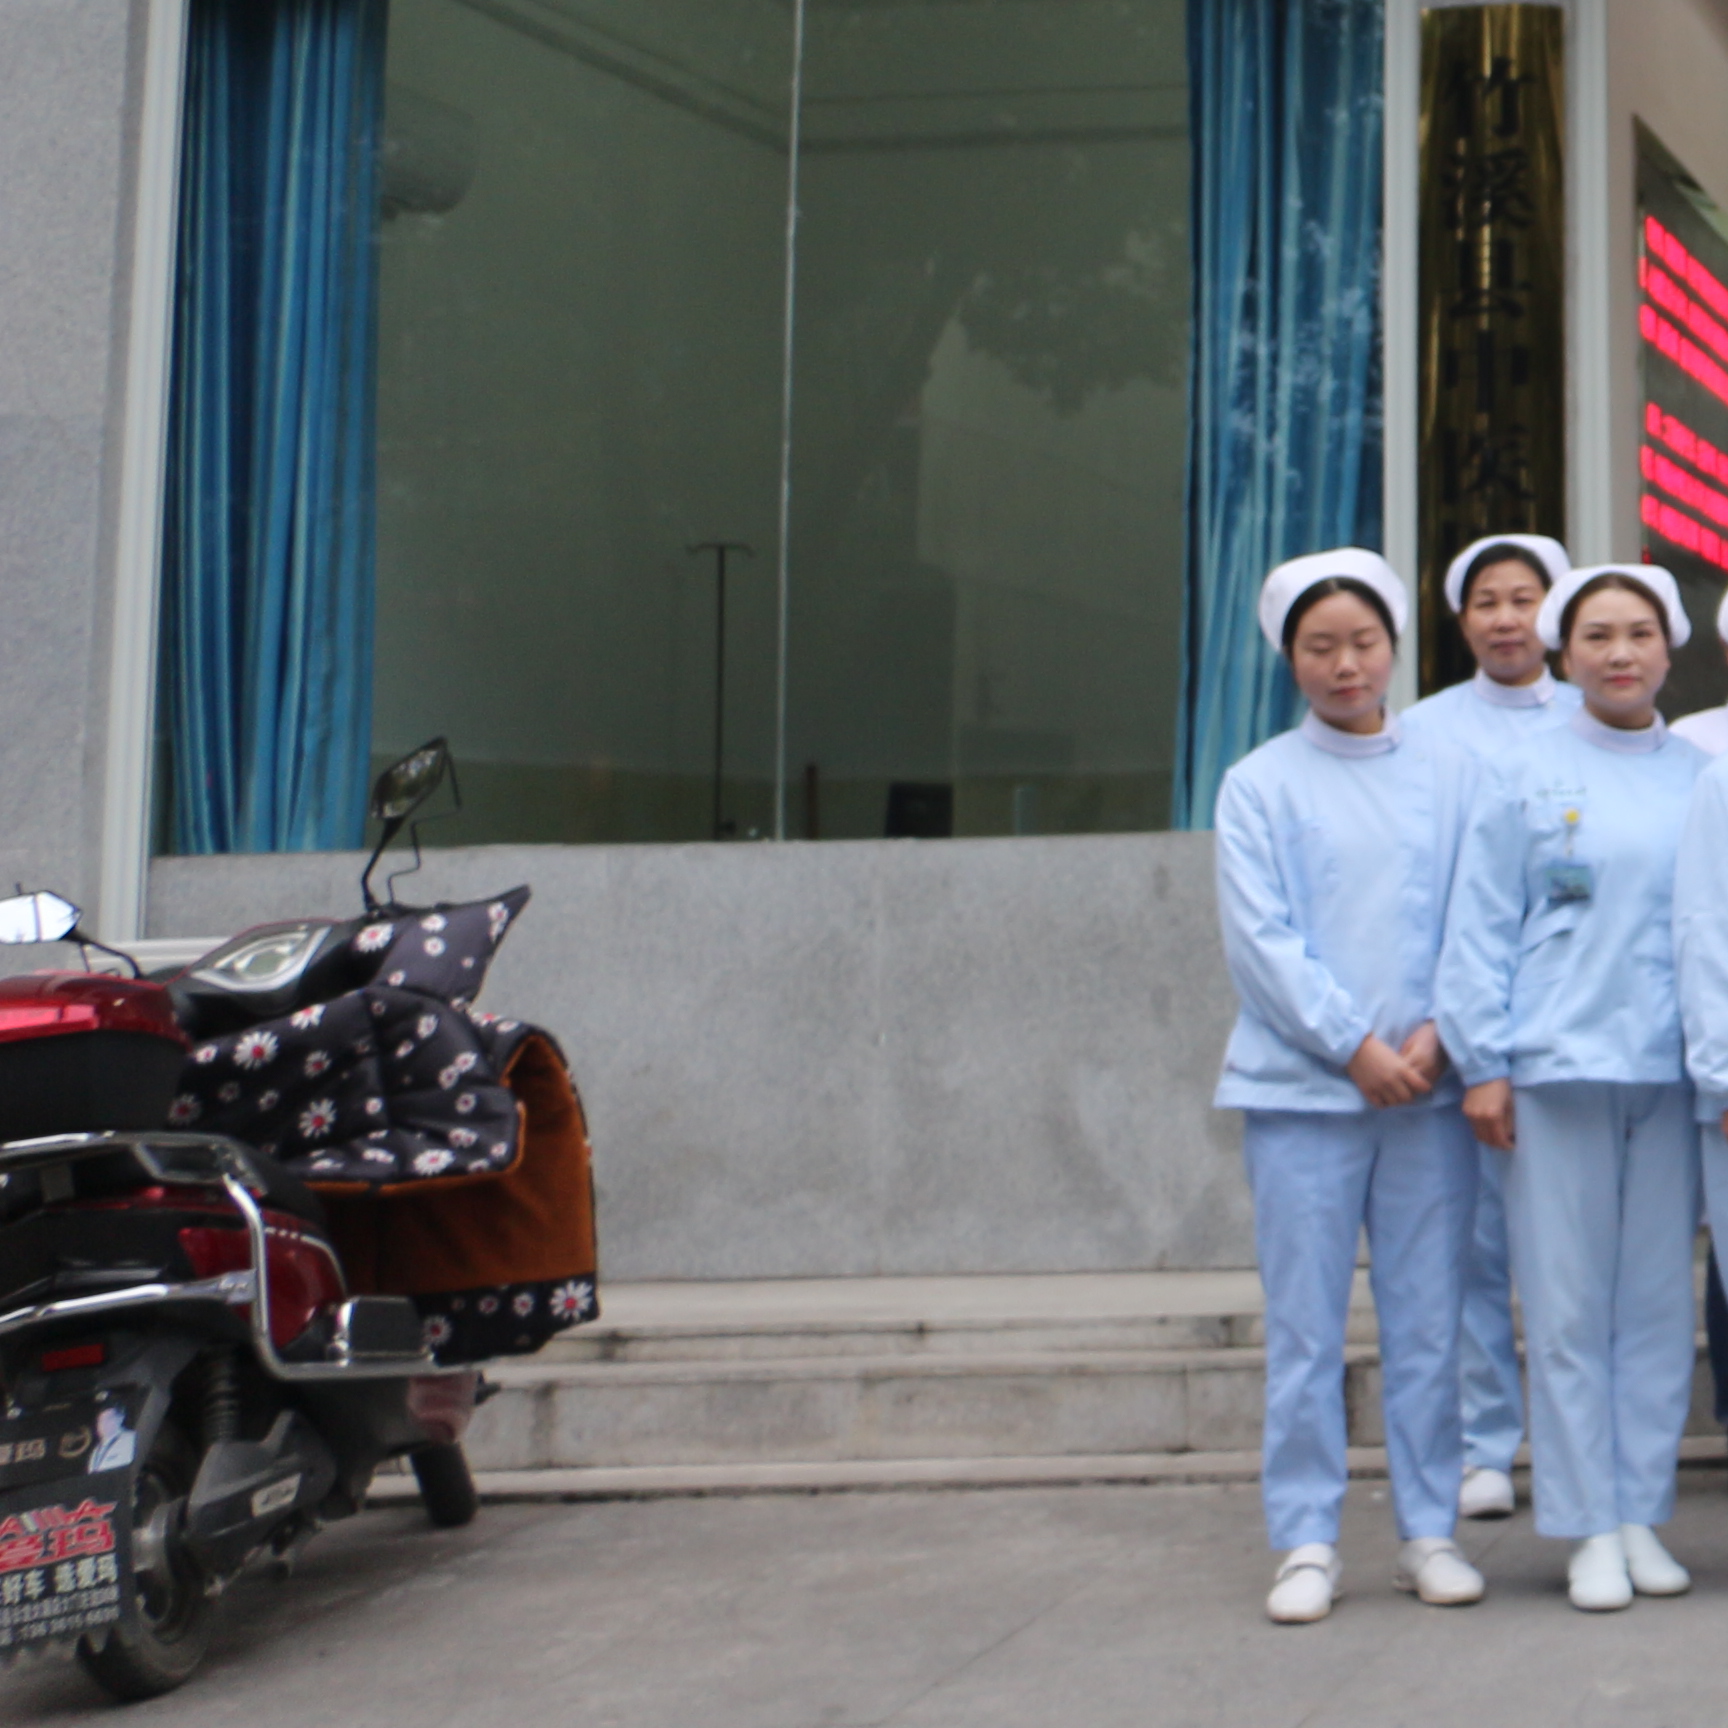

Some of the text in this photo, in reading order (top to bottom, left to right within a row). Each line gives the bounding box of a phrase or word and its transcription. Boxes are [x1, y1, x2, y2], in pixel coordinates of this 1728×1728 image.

[1436, 55, 1538, 557] 竹溪县中医
